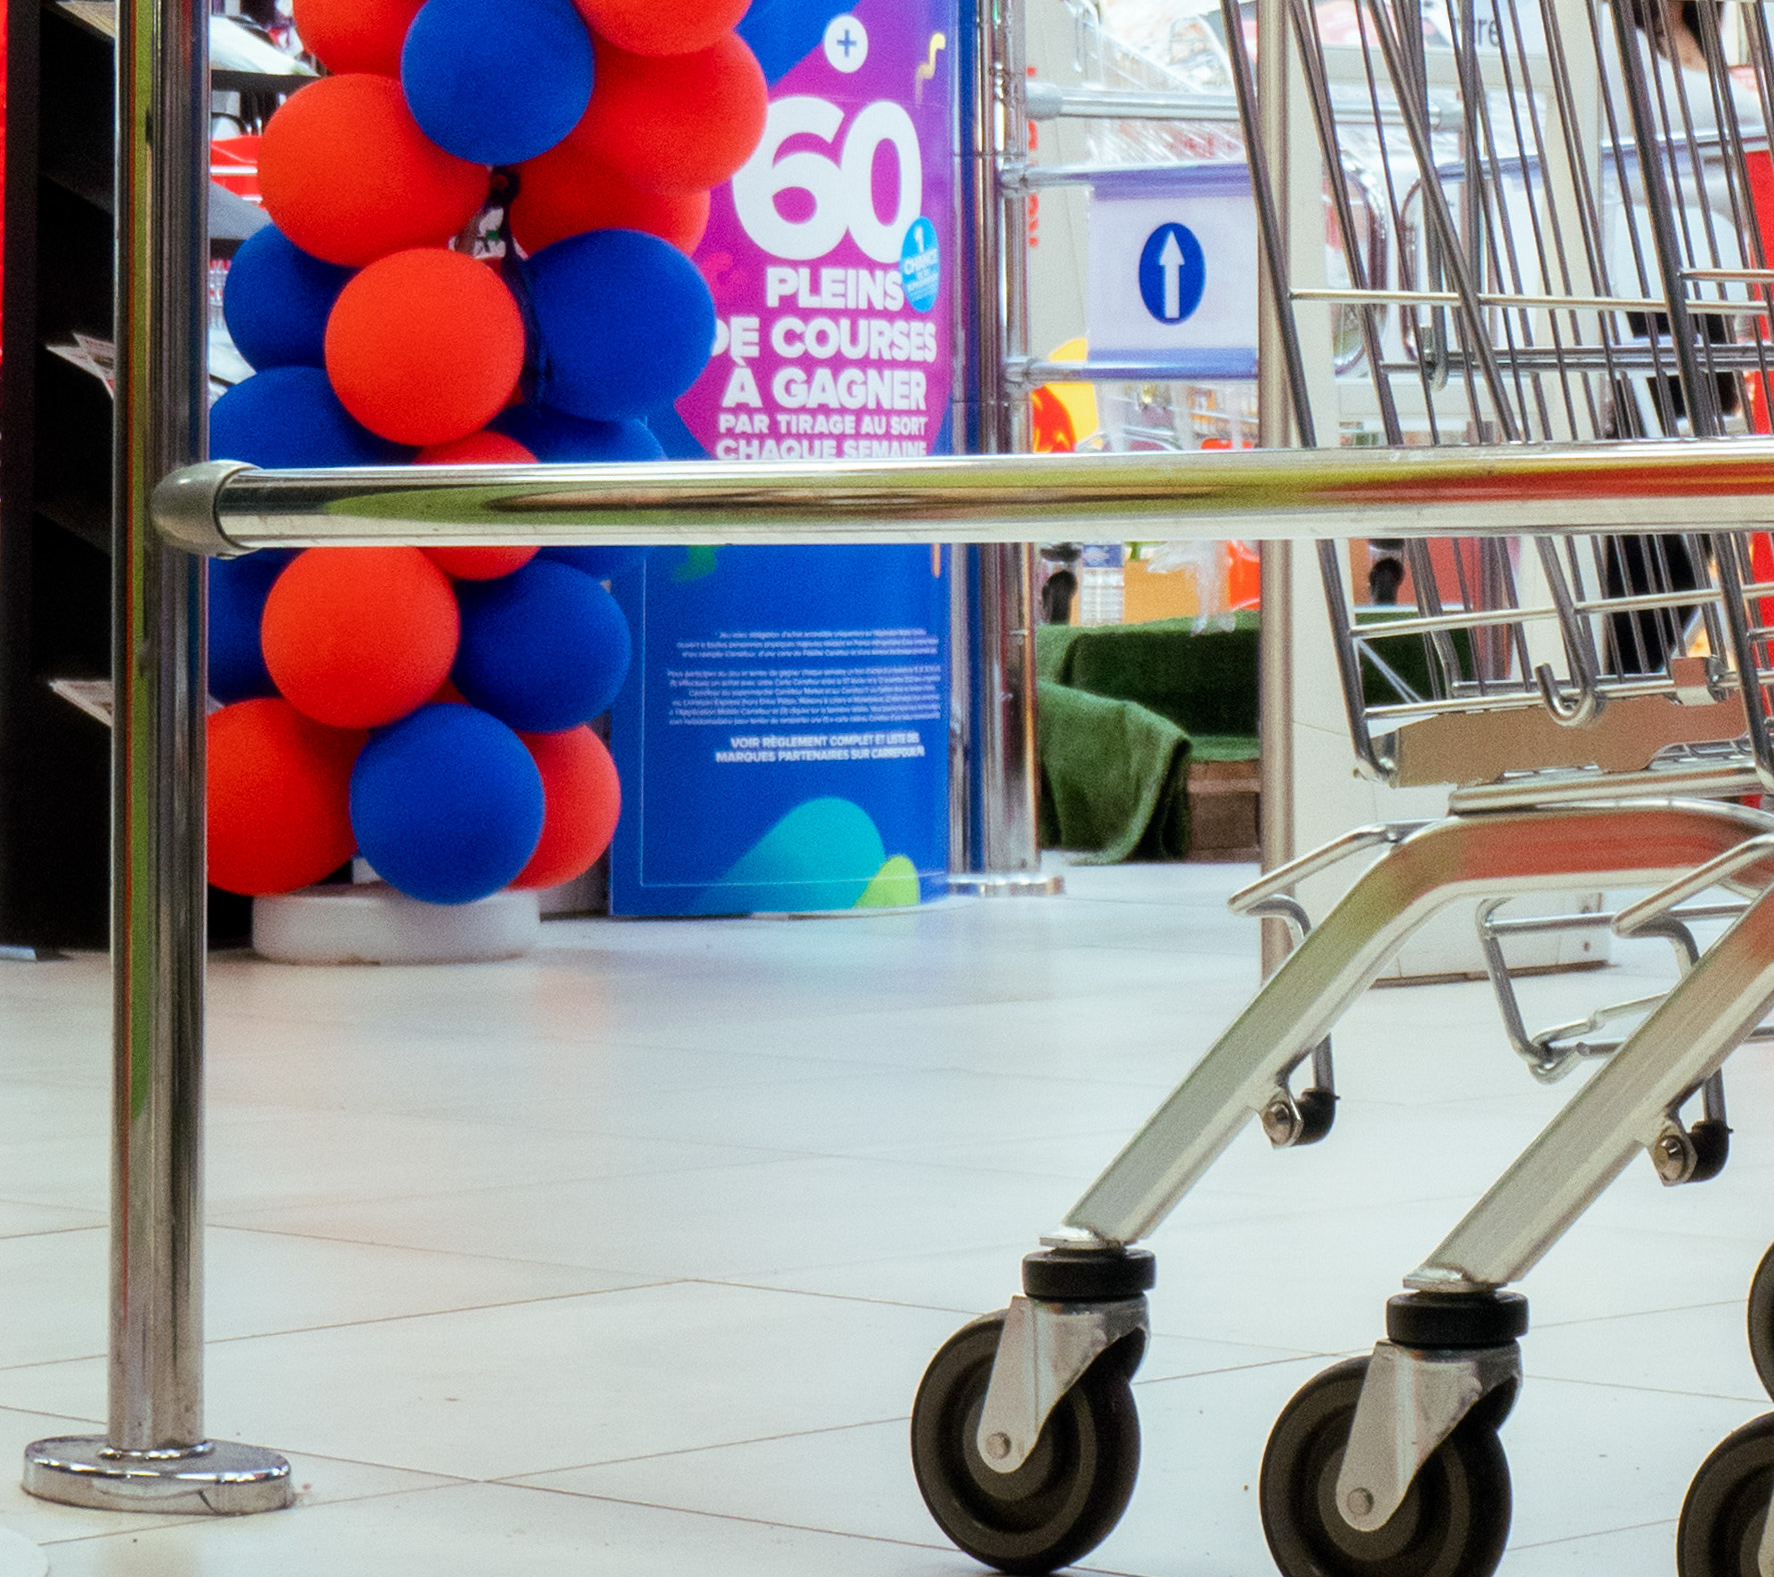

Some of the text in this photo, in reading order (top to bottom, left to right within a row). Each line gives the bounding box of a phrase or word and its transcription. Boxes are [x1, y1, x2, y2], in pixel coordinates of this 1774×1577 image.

[732, 94, 922, 264] 60
[912, 225, 925, 253] 1
[766, 266, 905, 311] PLEINS
[770, 316, 937, 363] COURSES
[721, 356, 927, 411] À GAGNER
[719, 413, 928, 437] PAR TIRAGE AU SORT
[715, 438, 928, 461] CHAQUE SEMAINE
[730, 736, 761, 749] VOIR
[762, 733, 828, 748] RÈGLEMENT
[829, 733, 874, 747] COMPLET
[715, 750, 776, 763] MARQUES
[778, 748, 850, 762] PARTENAIRES
[851, 748, 870, 761] SUR
